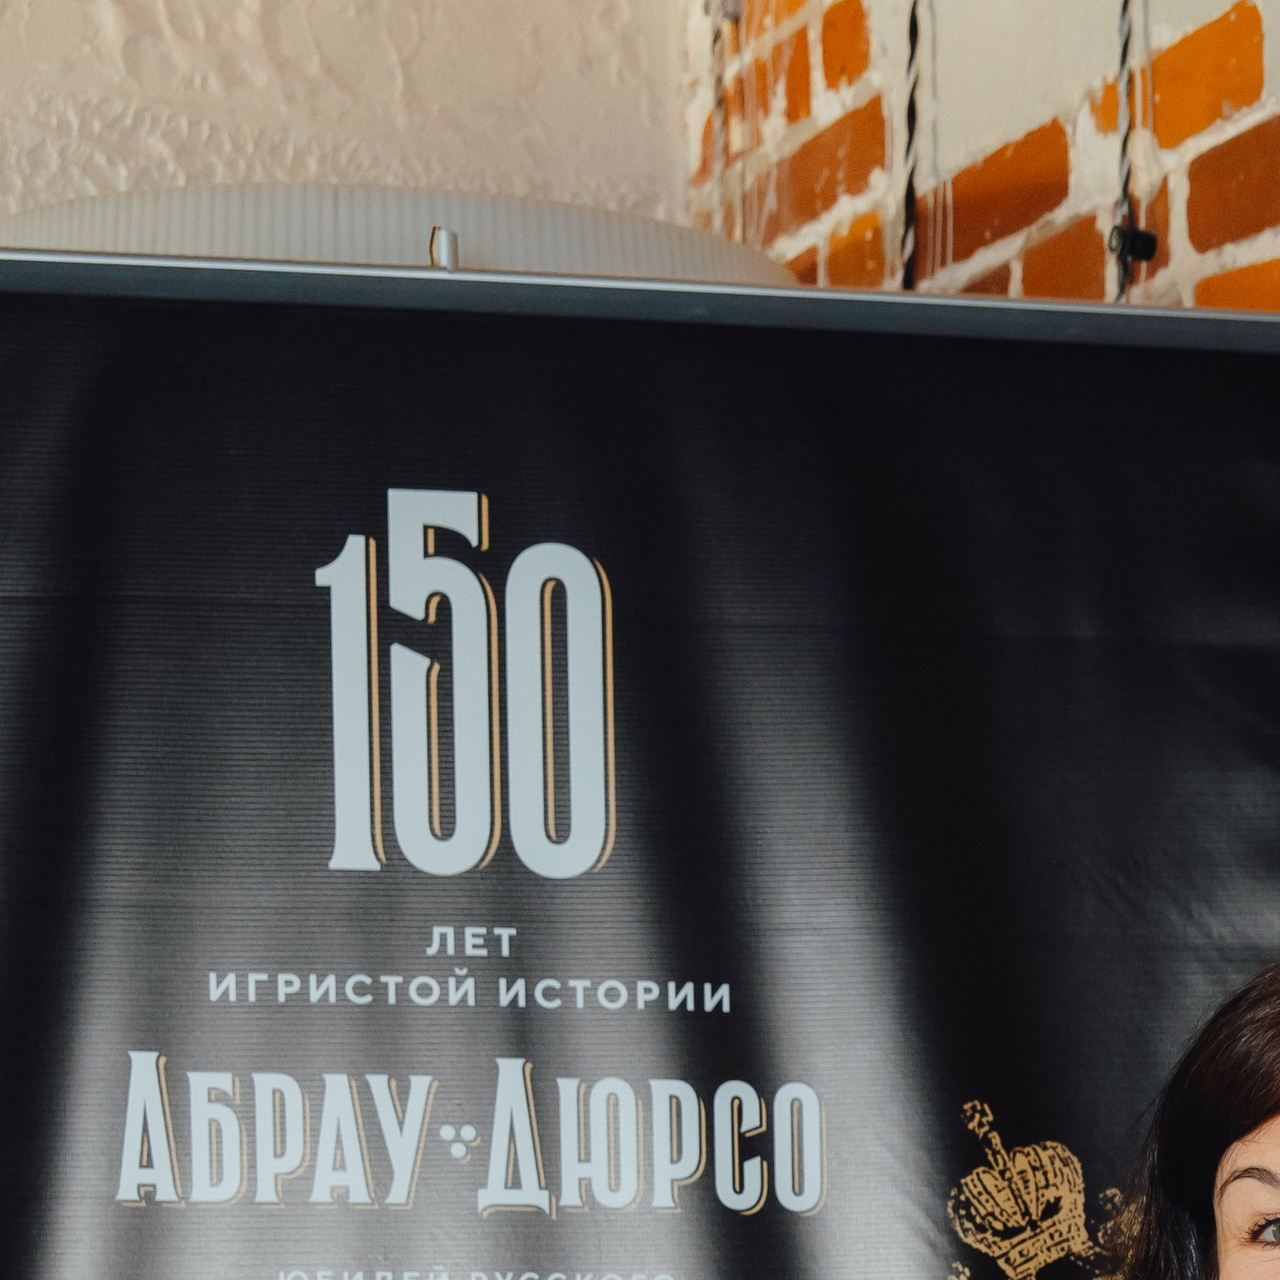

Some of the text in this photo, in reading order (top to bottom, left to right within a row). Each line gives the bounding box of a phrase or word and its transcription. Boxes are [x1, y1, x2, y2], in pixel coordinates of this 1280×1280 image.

[315, 488, 617, 880] 150
[208, 967, 732, 1014] ИГРИСТОЙ ИСТОРИИ
[426, 925, 518, 958] ЛЕТ
[114, 1050, 827, 1220] АБРАУ ДЮРСО
